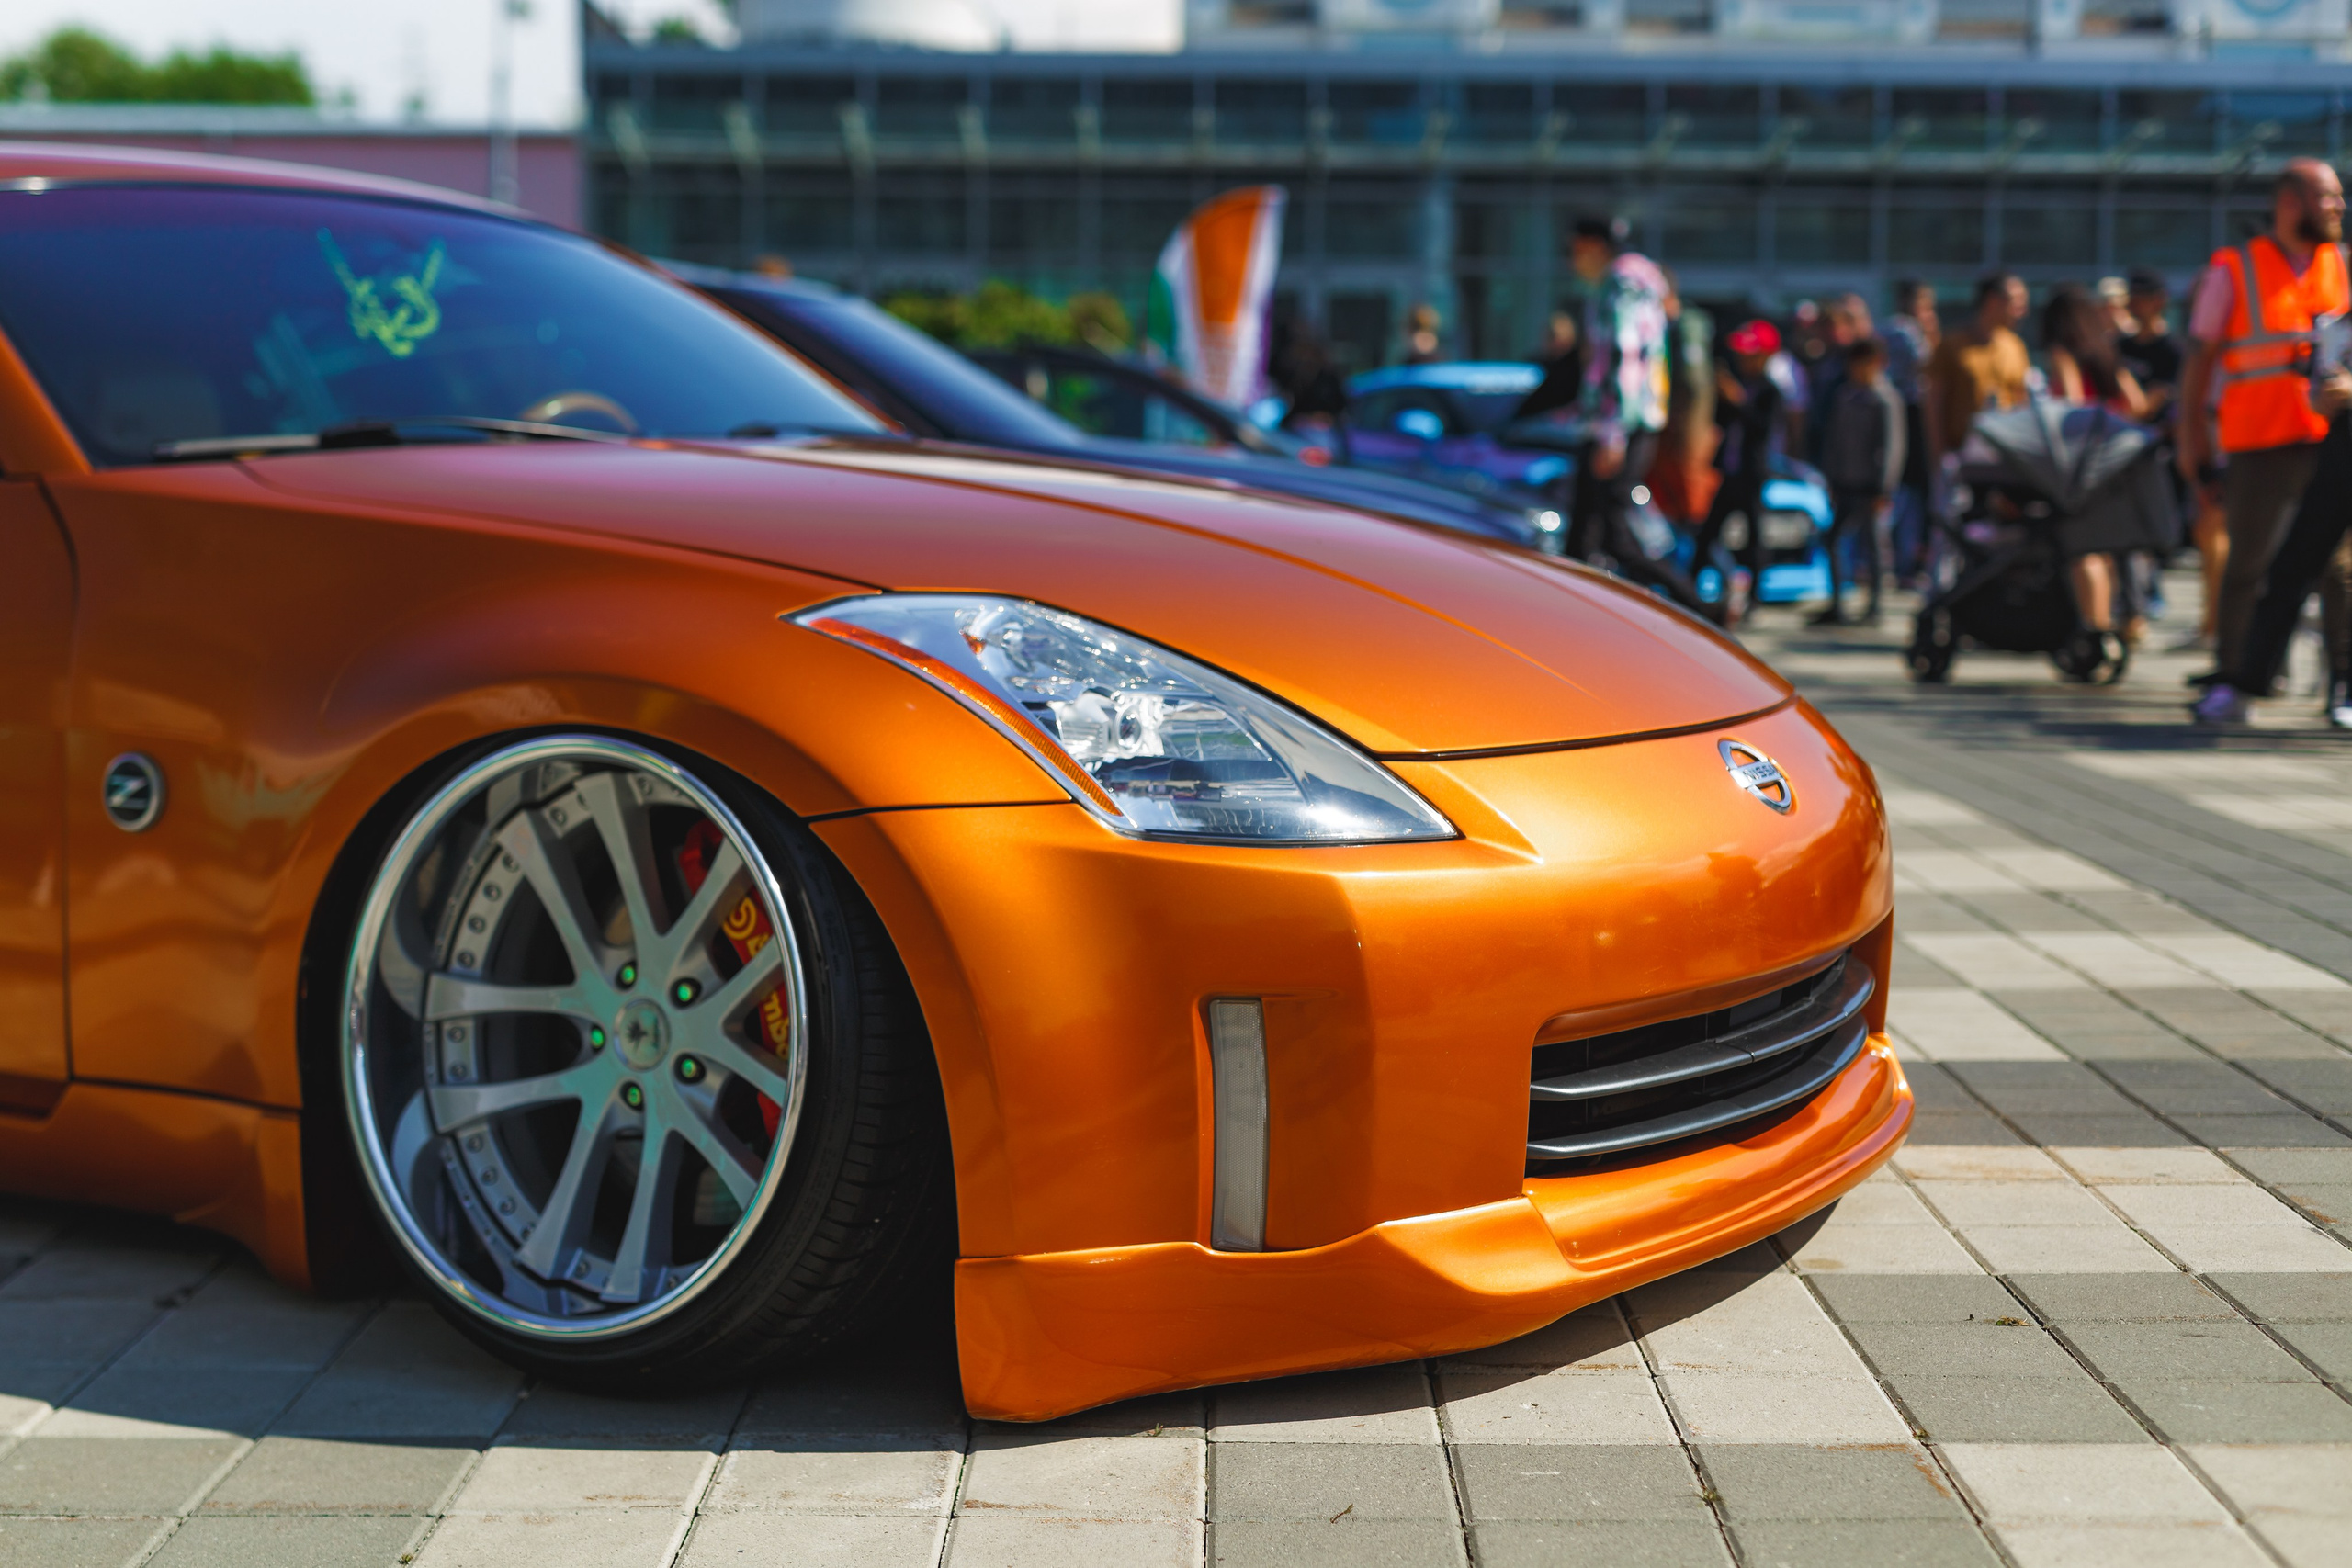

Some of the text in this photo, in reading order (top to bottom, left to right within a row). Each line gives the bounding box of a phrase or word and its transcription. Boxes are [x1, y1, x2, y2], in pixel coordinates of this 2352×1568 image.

[1743, 764, 1776, 780] NISS
[108, 773, 147, 809] Z
[746, 932, 789, 1060] bmbo
